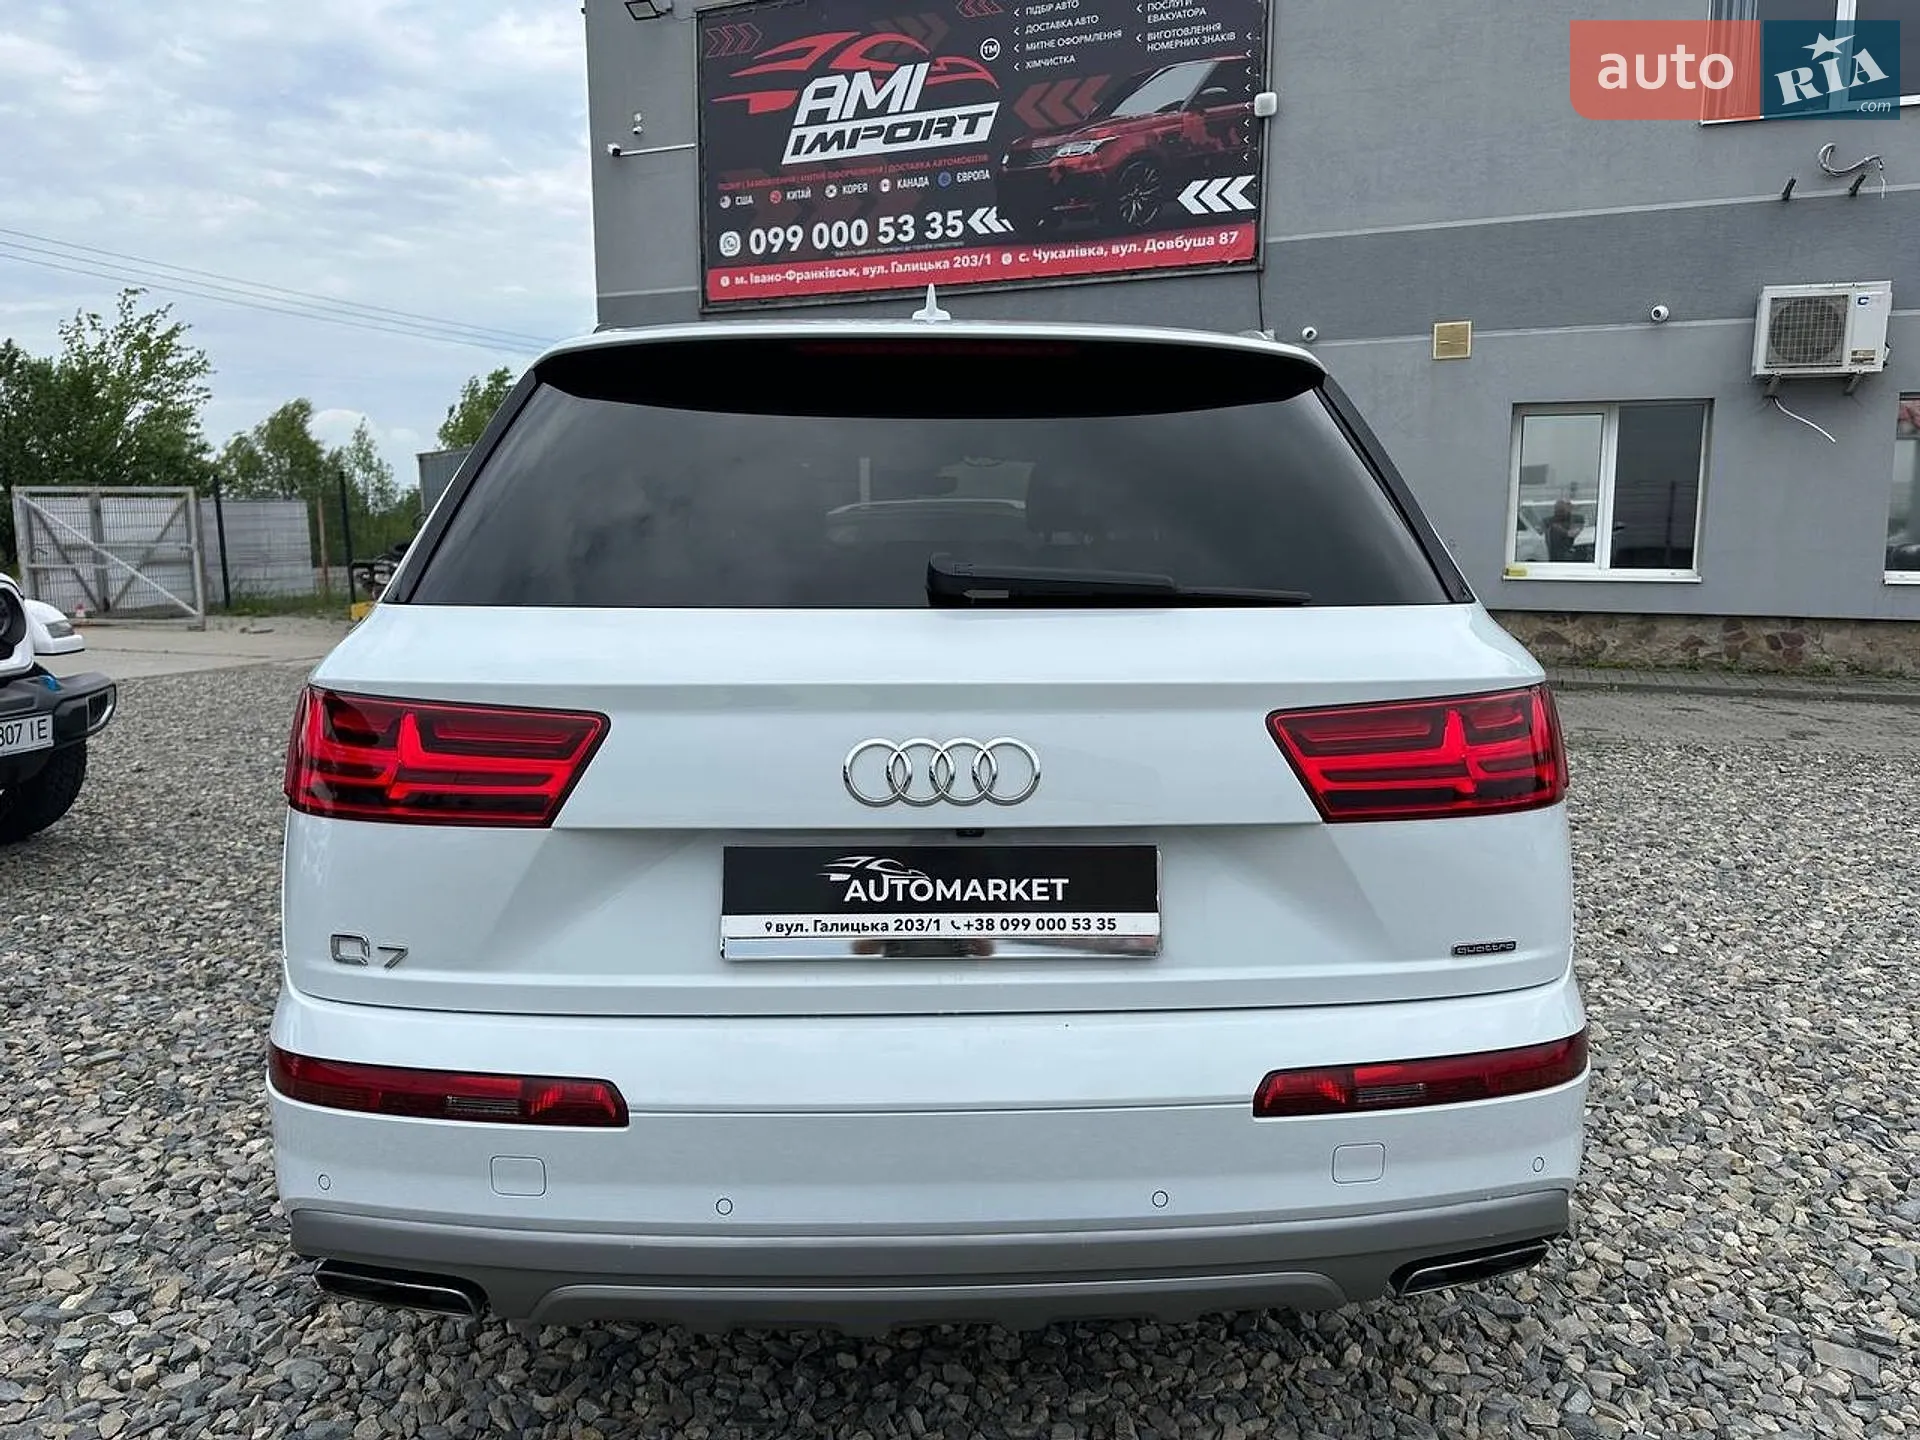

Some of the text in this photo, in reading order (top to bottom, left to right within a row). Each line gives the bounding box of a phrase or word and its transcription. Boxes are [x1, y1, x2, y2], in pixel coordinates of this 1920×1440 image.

[1025, 0, 1080, 15] ПІДБІР АВТО
[1147, 7, 1207, 23] ЕВАКУАТОРА
[1025, 14, 1099, 34] ДОСТАВКА АВТО
[1147, 22, 1221, 41] ВИГОТОВЛЕННЯ
[1025, 29, 1122, 51] МИТНЕ ОФОРМЛЕННЯ
[1147, 31, 1236, 52] НОМЕРНИХ ЗНАКІВ
[1025, 54, 1076, 70] ХІМЧИСТКА
[793, 62, 930, 125] AMI
[791, 111, 993, 155] IMPORT
[735, 195, 754, 206] США
[786, 186, 812, 200] КИТАЙ
[842, 182, 869, 195] КОРЕЯ
[897, 176, 930, 189] КАНАДА
[956, 169, 991, 183] ЄВРОПА
[749, 225, 804, 256] 099
[812, 218, 869, 250] 000
[877, 214, 915, 245] 53
[925, 210, 964, 239] 35
[734, 277, 747, 286] м.
[862, 262, 888, 276] вул.
[891, 256, 950, 274] Галицька
[953, 253, 991, 269] 203/1
[1018, 252, 1029, 263] с.
[1033, 244, 1110, 264] Чукалівка,
[1112, 242, 1142, 257] вул.
[1144, 236, 1215, 254] Довбуша
[1218, 230, 1239, 246] 87
[30, 719, 48, 741] IE
[844, 878, 1070, 902] AUTOMARKET
[775, 918, 1117, 936] вул. Галицька 203/1 +38 099 000 53 35
[330, 933, 409, 969] Q7
[1456, 943, 1515, 955] quattro
